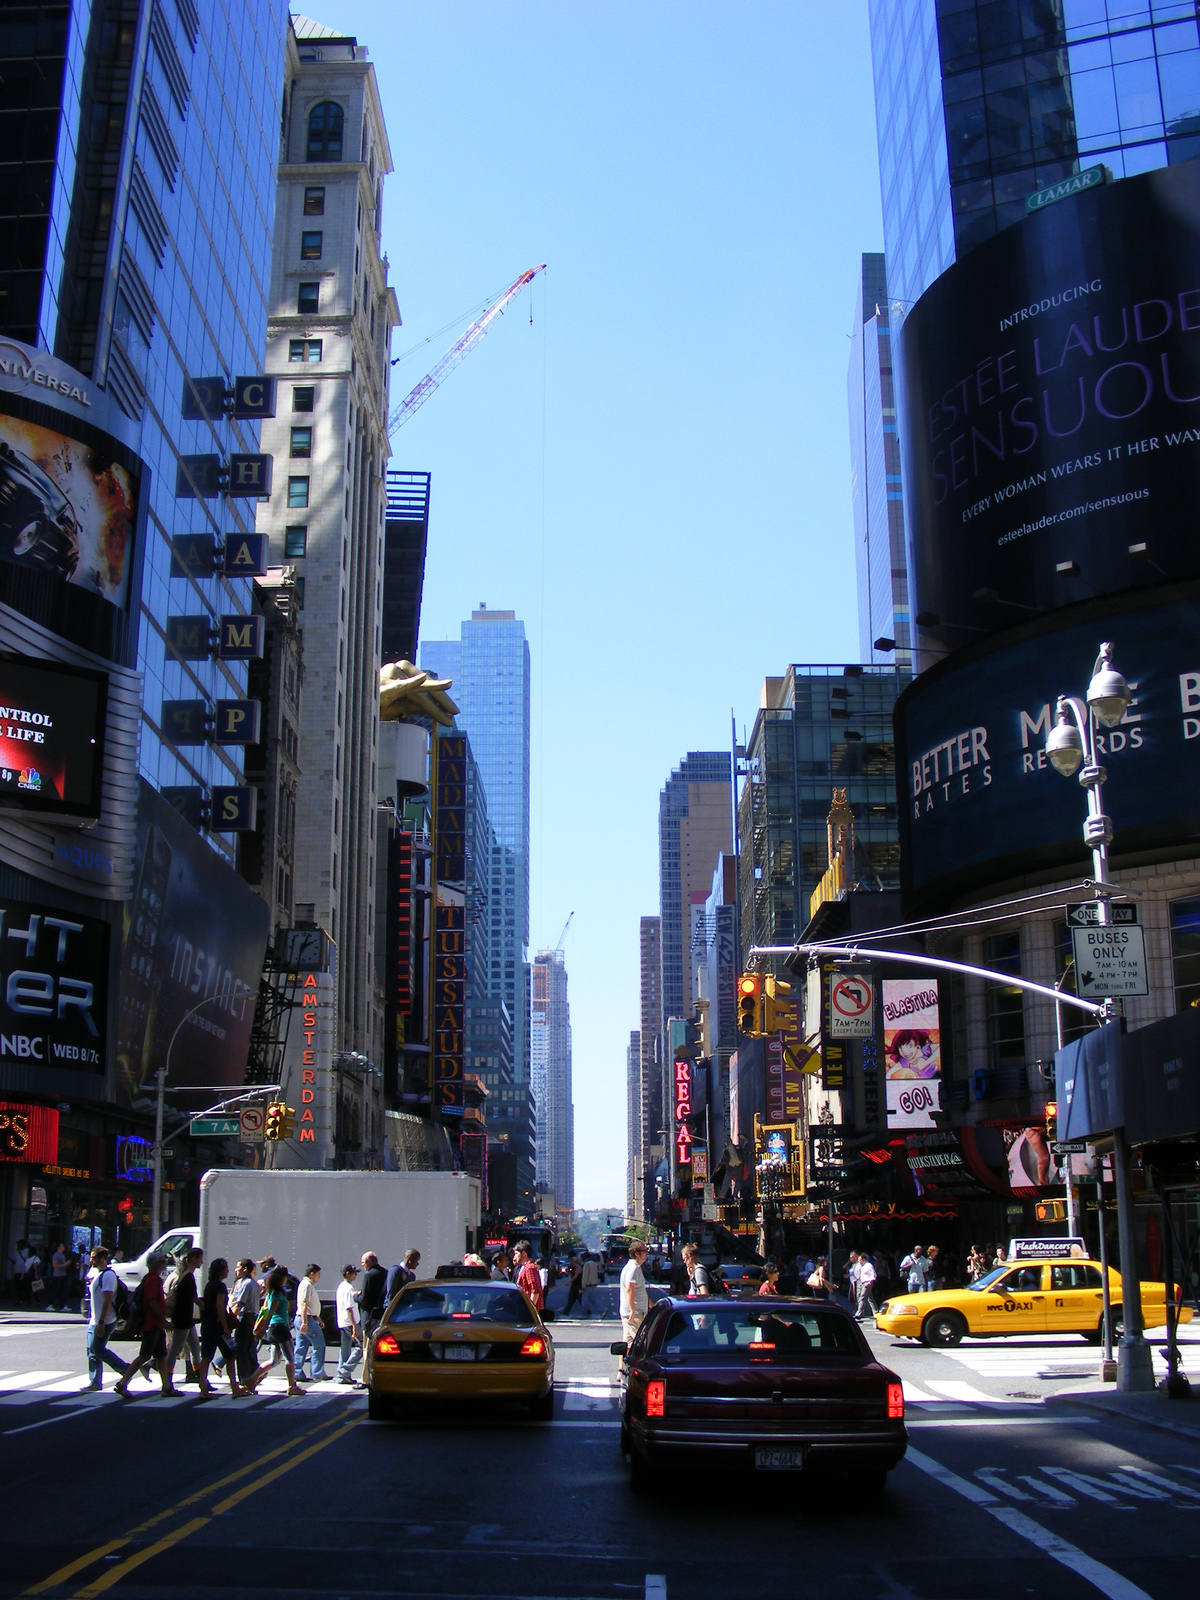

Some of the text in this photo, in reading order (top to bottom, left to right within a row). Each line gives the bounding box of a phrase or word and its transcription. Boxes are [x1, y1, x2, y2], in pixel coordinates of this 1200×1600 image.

[1036, 172, 1092, 206] LAMAR
[999, 279, 1102, 332] INTRODUCING
[962, 427, 1200, 523] EVERY WOMAN WEARS IT HER WAY
[997, 487, 1150, 546] esteelauder.com/sensuous
[6, 726, 45, 744] LIFE
[912, 726, 991, 796] BETTER
[17, 782, 42, 791] CNBC
[914, 765, 993, 820] RATES
[440, 738, 463, 879] MADAME
[57, 843, 112, 875] AQUOS
[717, 906, 733, 934] NEW
[1077, 910, 1097, 919] ONE
[1087, 932, 1129, 945] BUSES
[1092, 946, 1126, 959] ONLY
[439, 907, 460, 1105] TUSSAUD'S
[883, 989, 938, 1021] ELASTIKA
[834, 1018, 870, 1027] 7AM-7PM
[0, 1033, 43, 1059] NBC
[53, 1043, 79, 1060] WED
[299, 973, 319, 1142] AMSTERDAM
[826, 1046, 843, 1085] NEW
[675, 1062, 692, 1163] REGAL
[785, 1082, 800, 1115] NEW
[899, 1086, 933, 1114] GO!
[210, 1122, 239, 1132] 7 Av
[906, 1153, 951, 1170] QUIKSILVER
[1016, 1241, 1071, 1251] FlashDancers
[1004, 1300, 1032, 1311] TAXI
